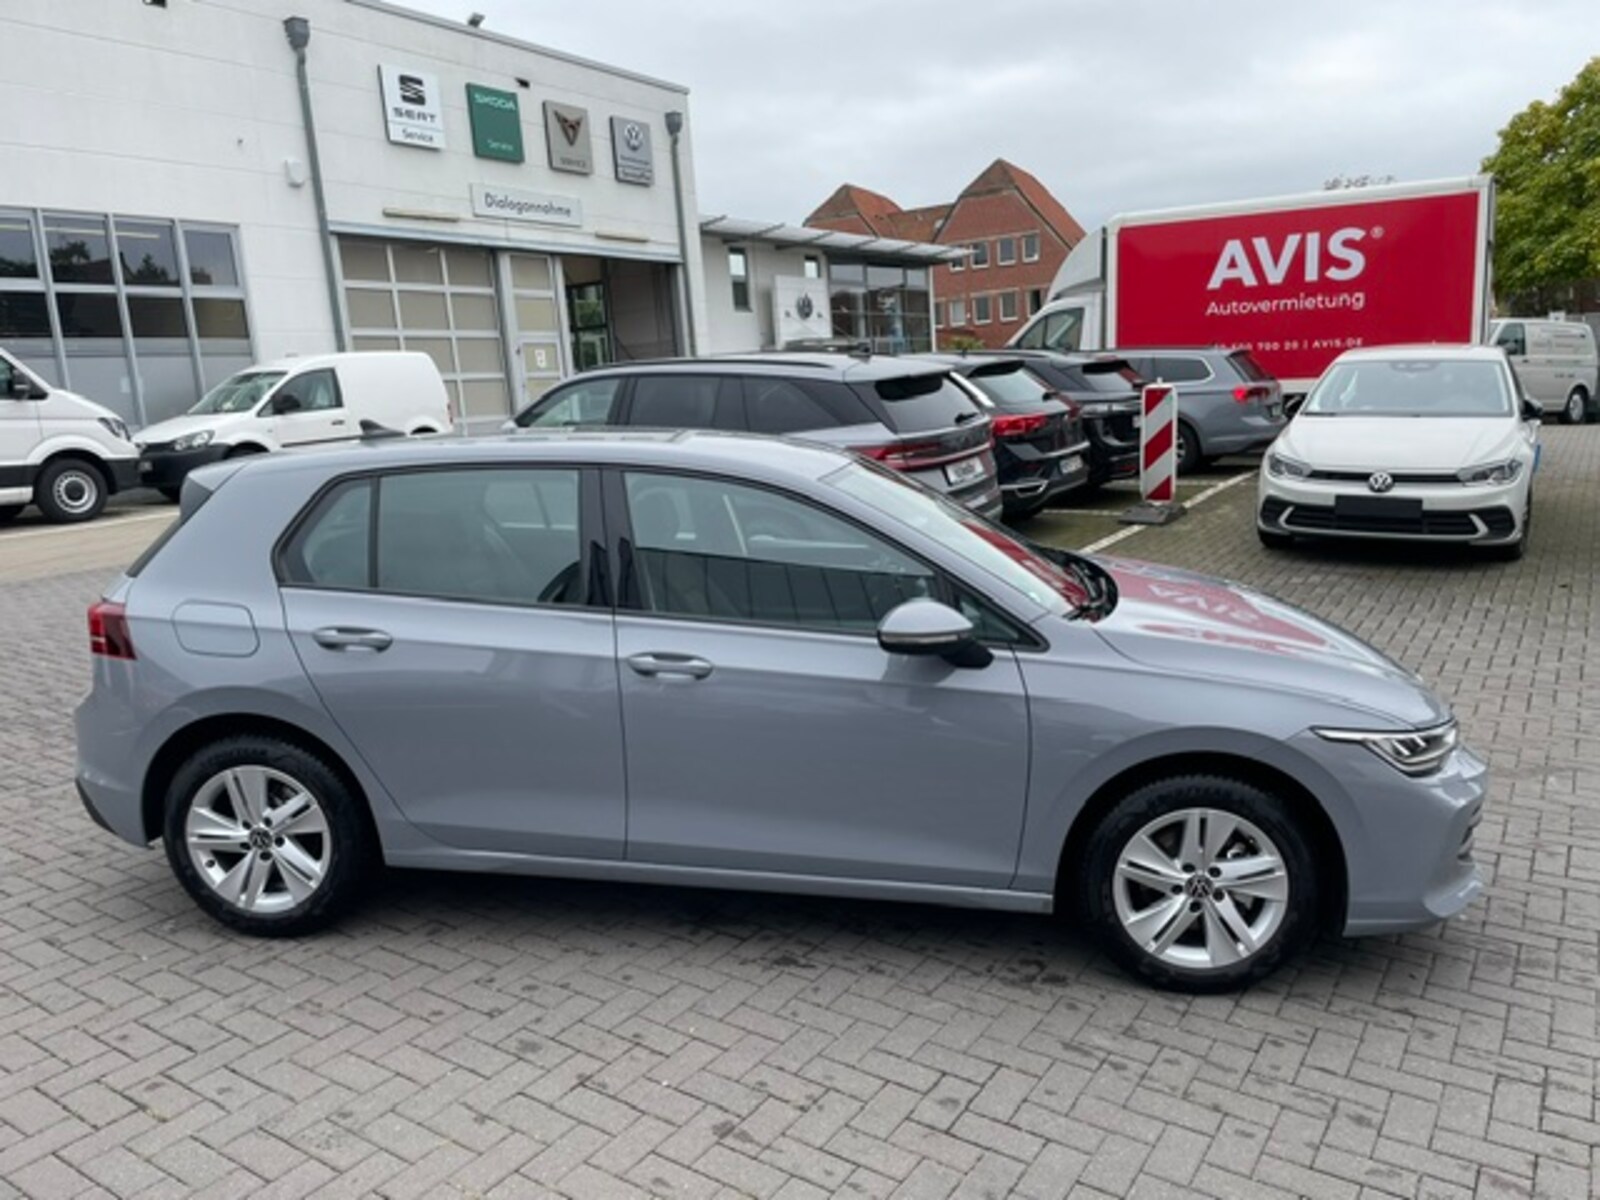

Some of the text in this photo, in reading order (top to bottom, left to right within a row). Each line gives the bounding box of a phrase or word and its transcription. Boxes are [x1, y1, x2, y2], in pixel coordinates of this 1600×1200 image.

[393, 107, 436, 123] SEAT
[402, 128, 434, 143] Service
[485, 191, 571, 217] Dialogannahme
[1206, 226, 1367, 290] AVIS
[1205, 292, 1366, 315] Autovermietung
[1312, 337, 1363, 349] AVIS.DE
